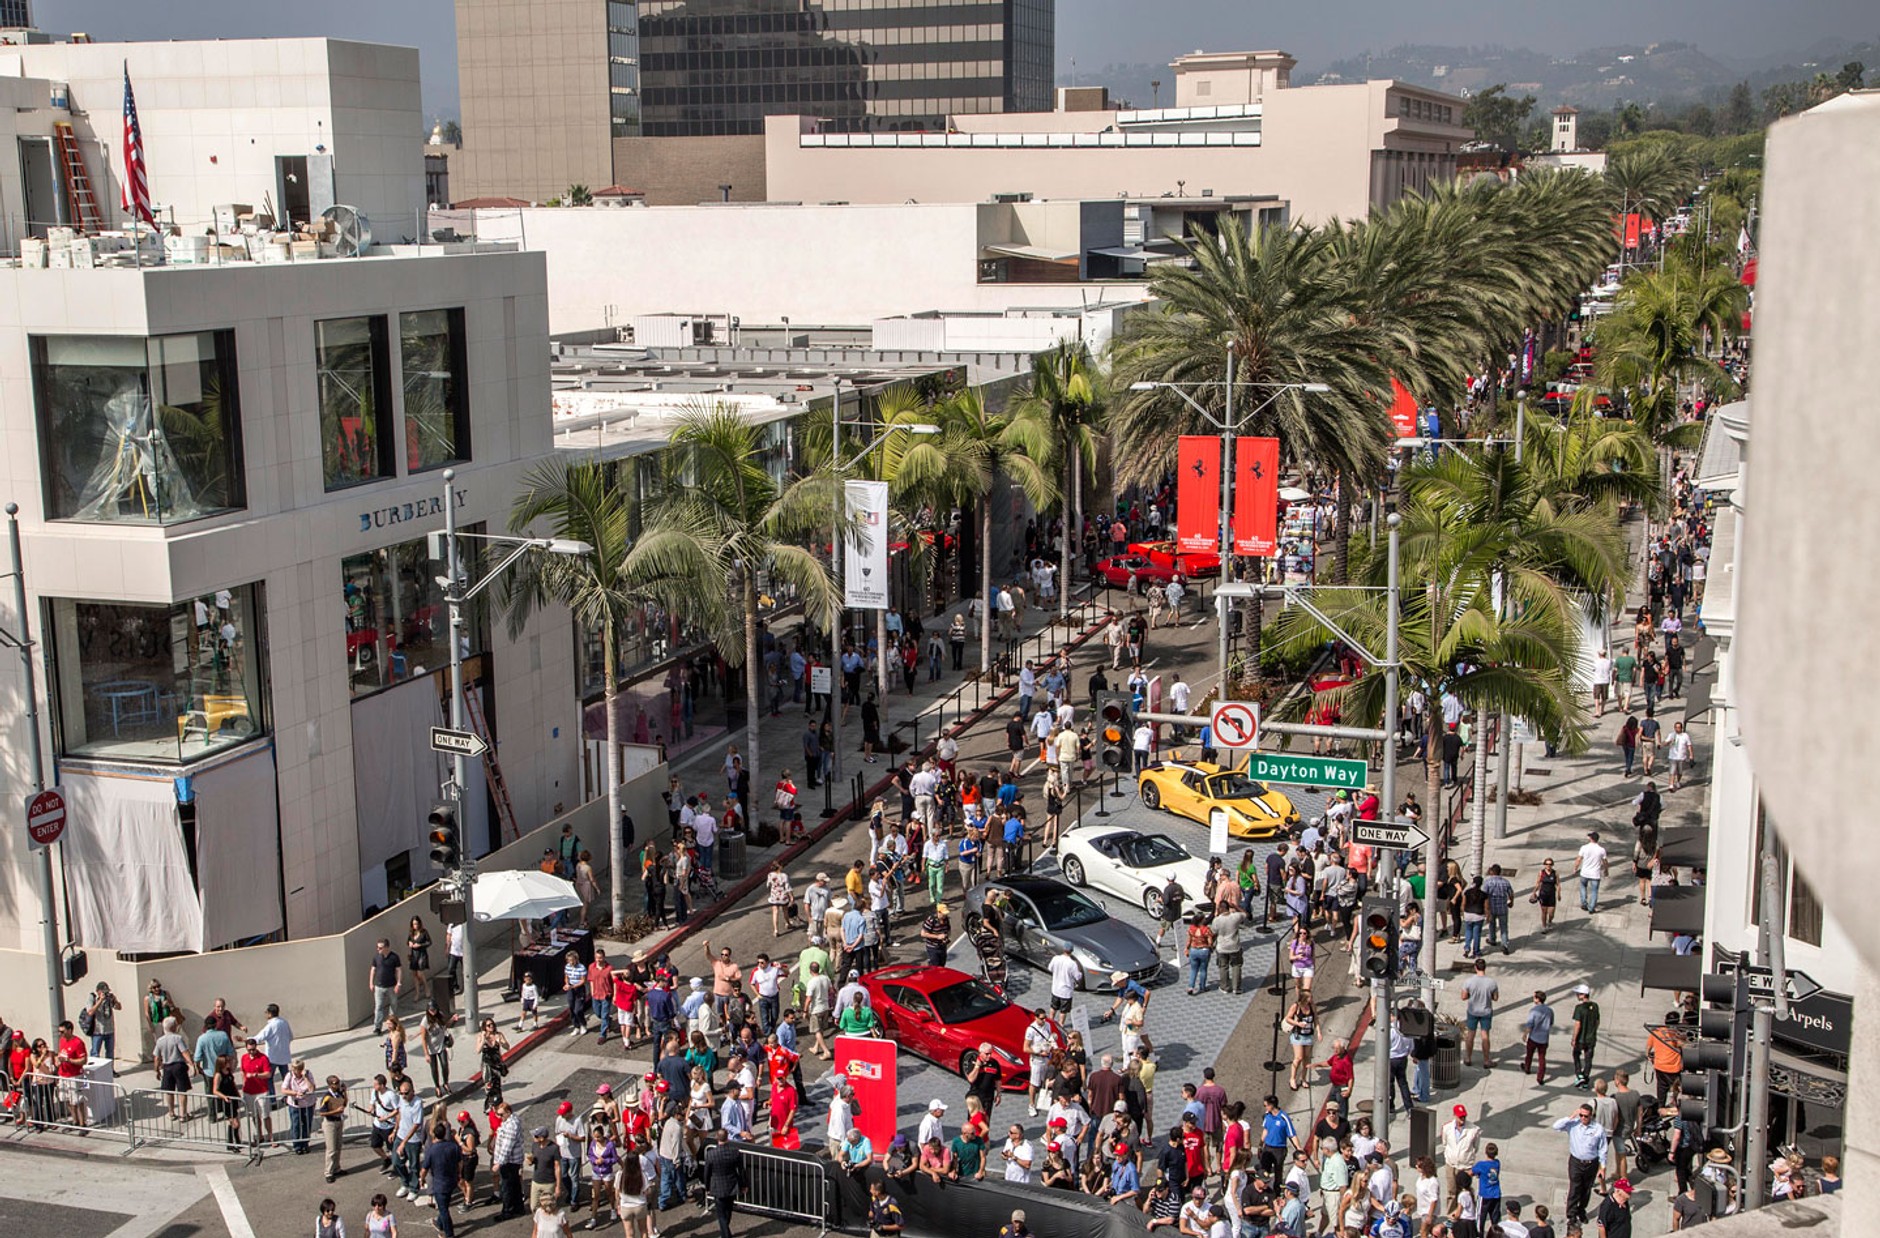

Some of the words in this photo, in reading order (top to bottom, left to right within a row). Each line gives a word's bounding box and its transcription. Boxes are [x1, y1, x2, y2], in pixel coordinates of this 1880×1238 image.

[359, 489, 468, 532] BURBERY
[437, 735, 453, 746] ONE
[454, 739, 470, 748] WAY
[1257, 760, 1318, 780] Dayton
[1323, 765, 1358, 785] Way
[32, 803, 43, 815] DO
[45, 797, 59, 811] NOT
[36, 821, 59, 837] ENTER
[1360, 828, 1382, 840] ONE
[1385, 830, 1407, 841] WAY
[1789, 1006, 1834, 1032] Arpels
